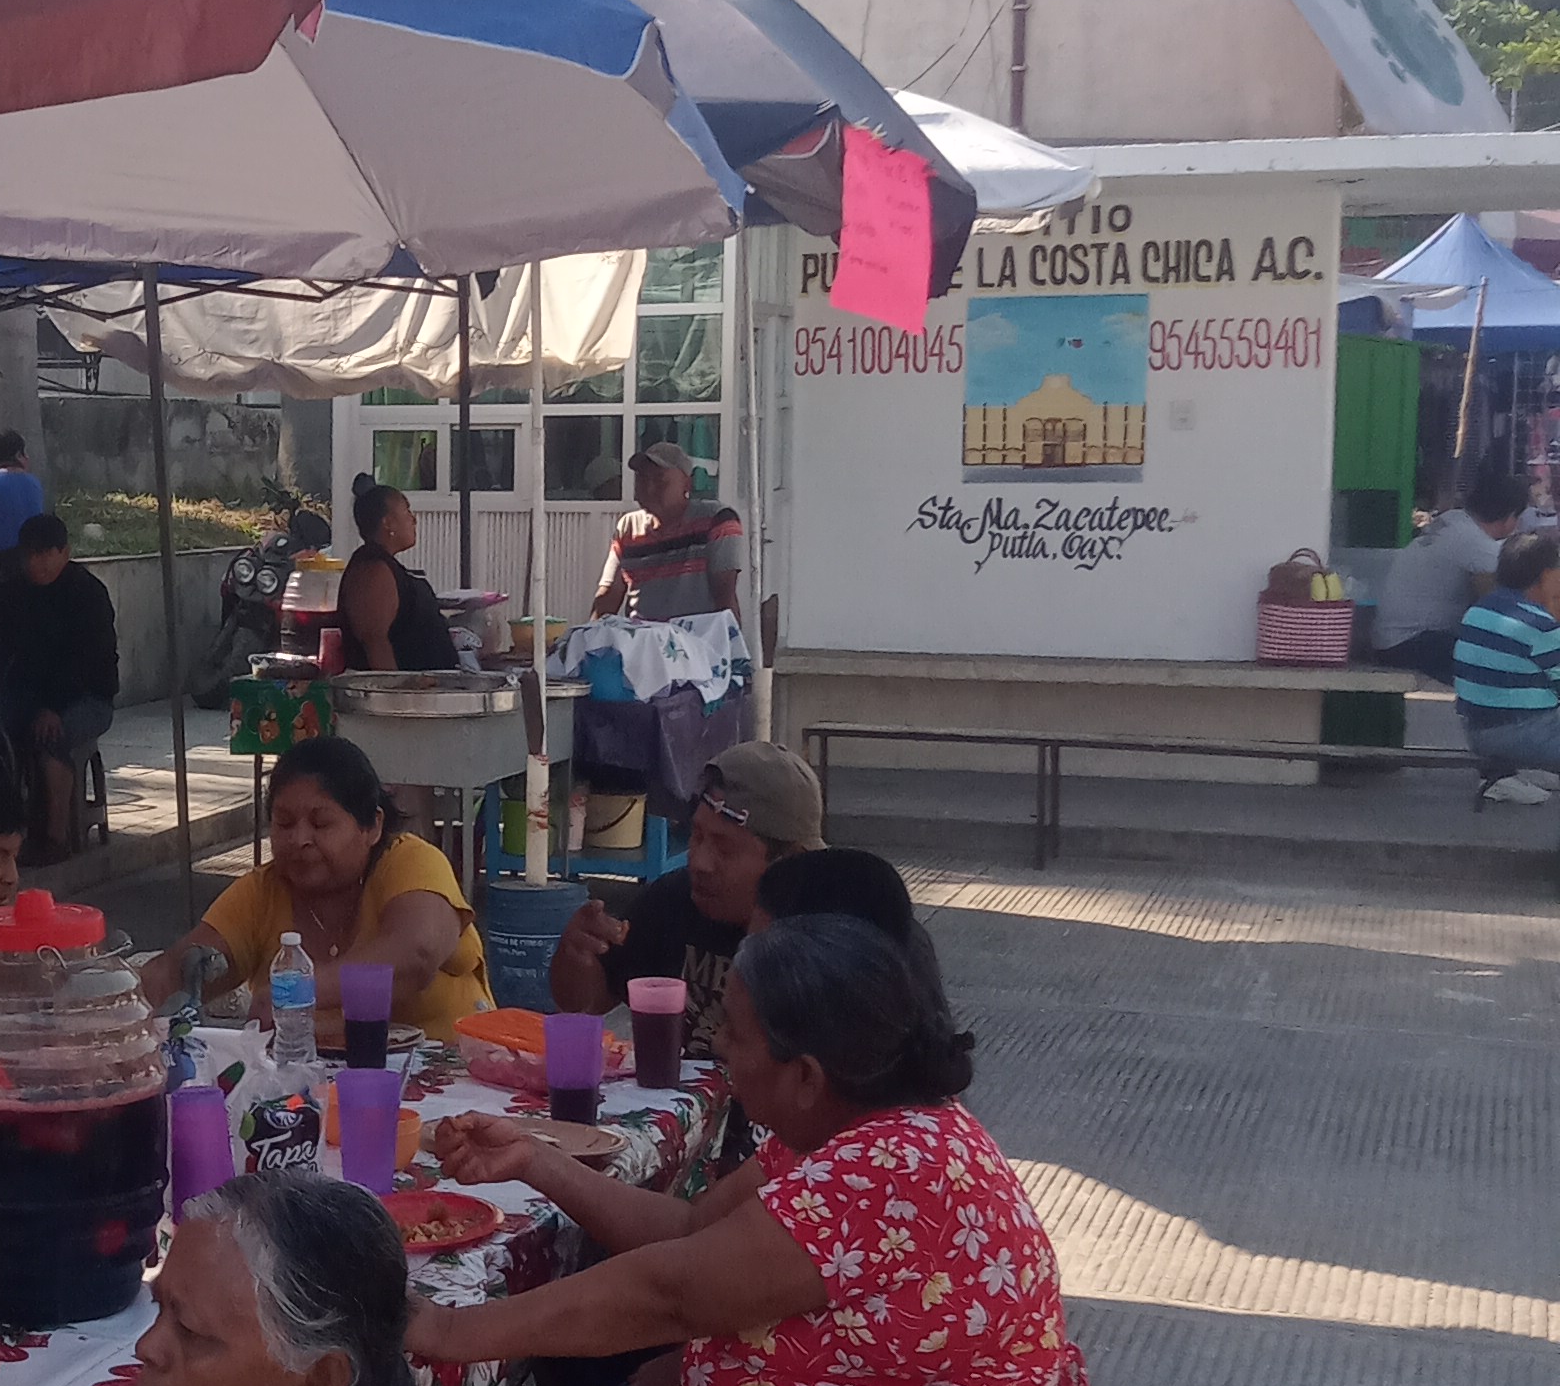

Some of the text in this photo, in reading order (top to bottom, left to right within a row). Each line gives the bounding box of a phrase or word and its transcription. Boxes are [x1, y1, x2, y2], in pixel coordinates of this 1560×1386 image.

[977, 245, 1017, 289] LA
[1029, 241, 1131, 287] COSTA
[1141, 237, 1236, 285] CHICA
[1250, 235, 1324, 282] A.C.
[793, 324, 965, 377] 9541004045
[1147, 316, 1322, 372] 9545559401
